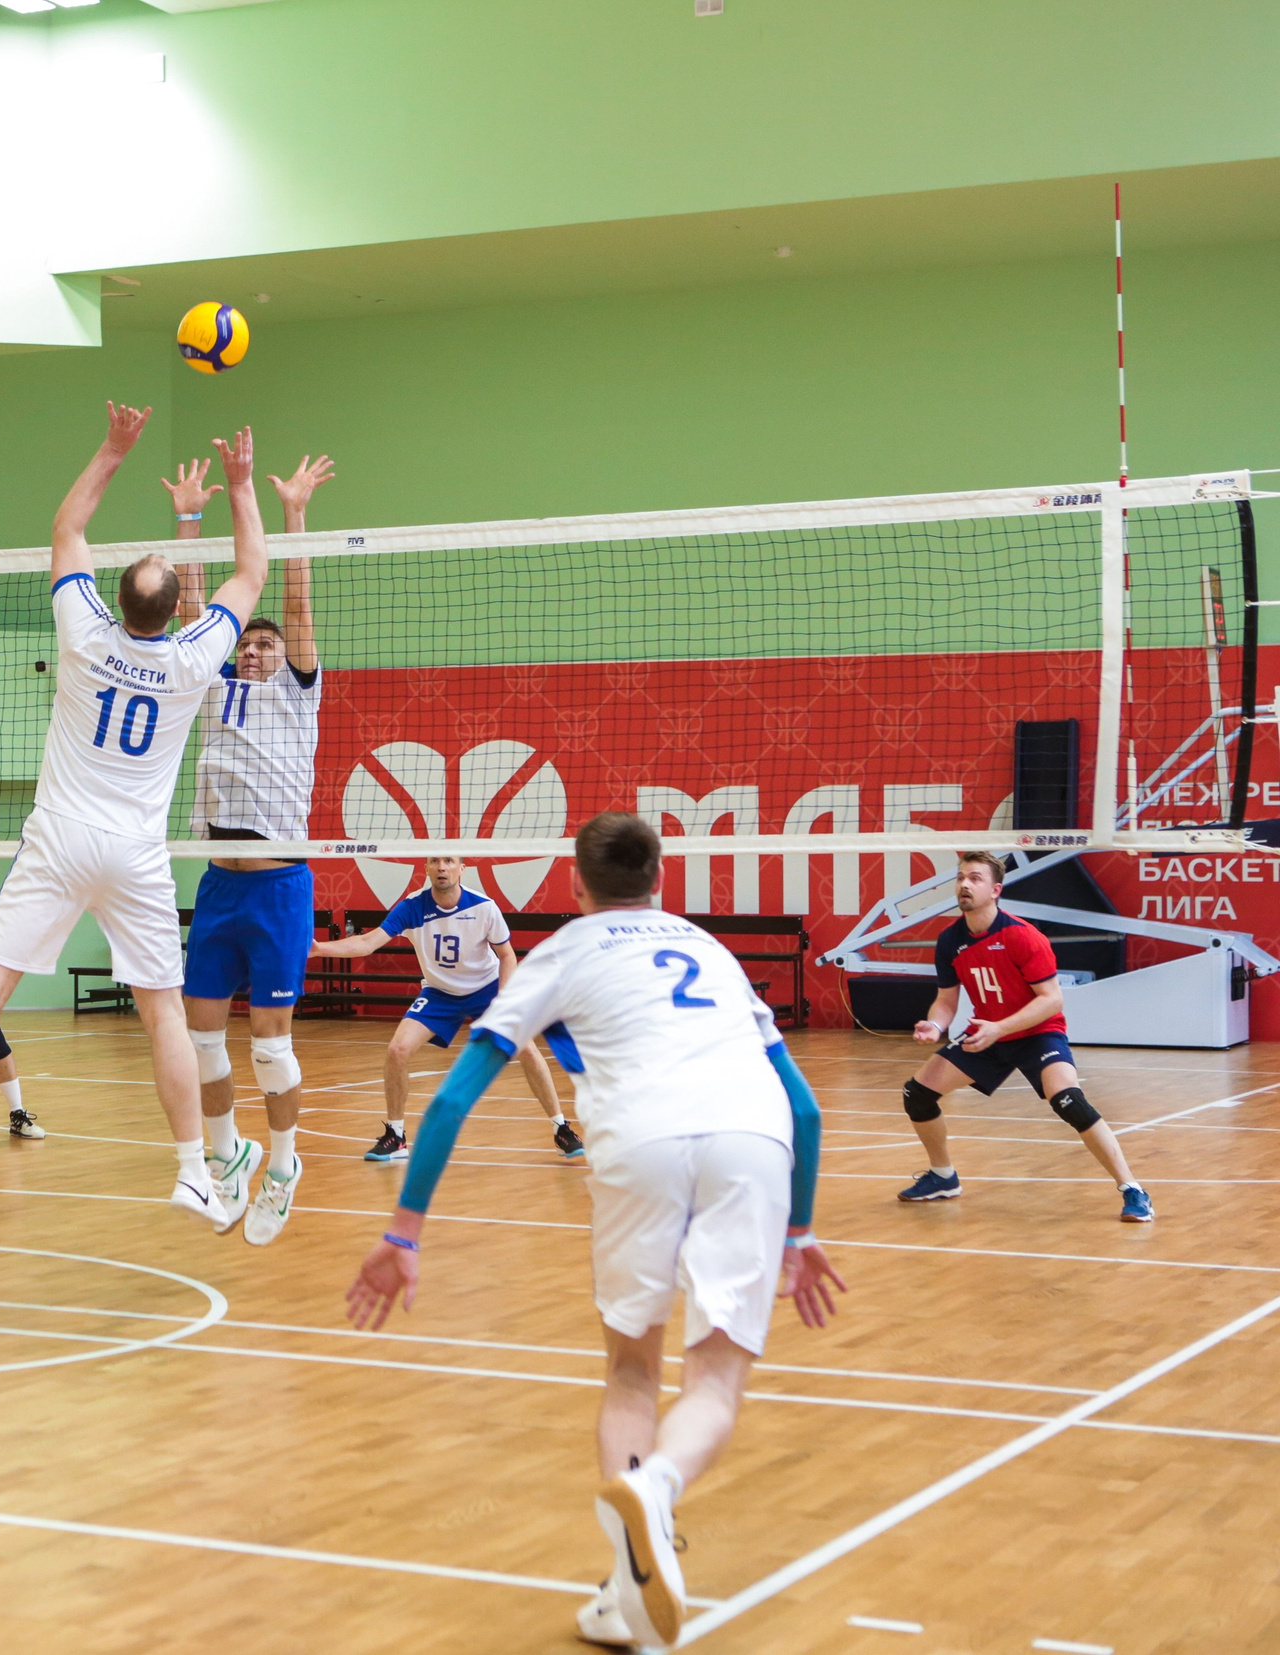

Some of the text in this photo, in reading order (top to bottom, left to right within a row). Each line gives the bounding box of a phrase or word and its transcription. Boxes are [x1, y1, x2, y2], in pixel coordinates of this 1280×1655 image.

[90, 663, 115, 680] ЦЕНТР
[115, 676, 123, 685] И
[105, 655, 166, 684] РОССЕТИ
[221, 679, 251, 728] 11
[93, 686, 159, 757] 10
[1139, 858, 1280, 882] БАСКЕТ
[1137, 895, 1238, 921] ЛИГА
[433, 933, 460, 963] 13
[653, 950, 717, 1008] 2
[970, 966, 1004, 1004] 14
